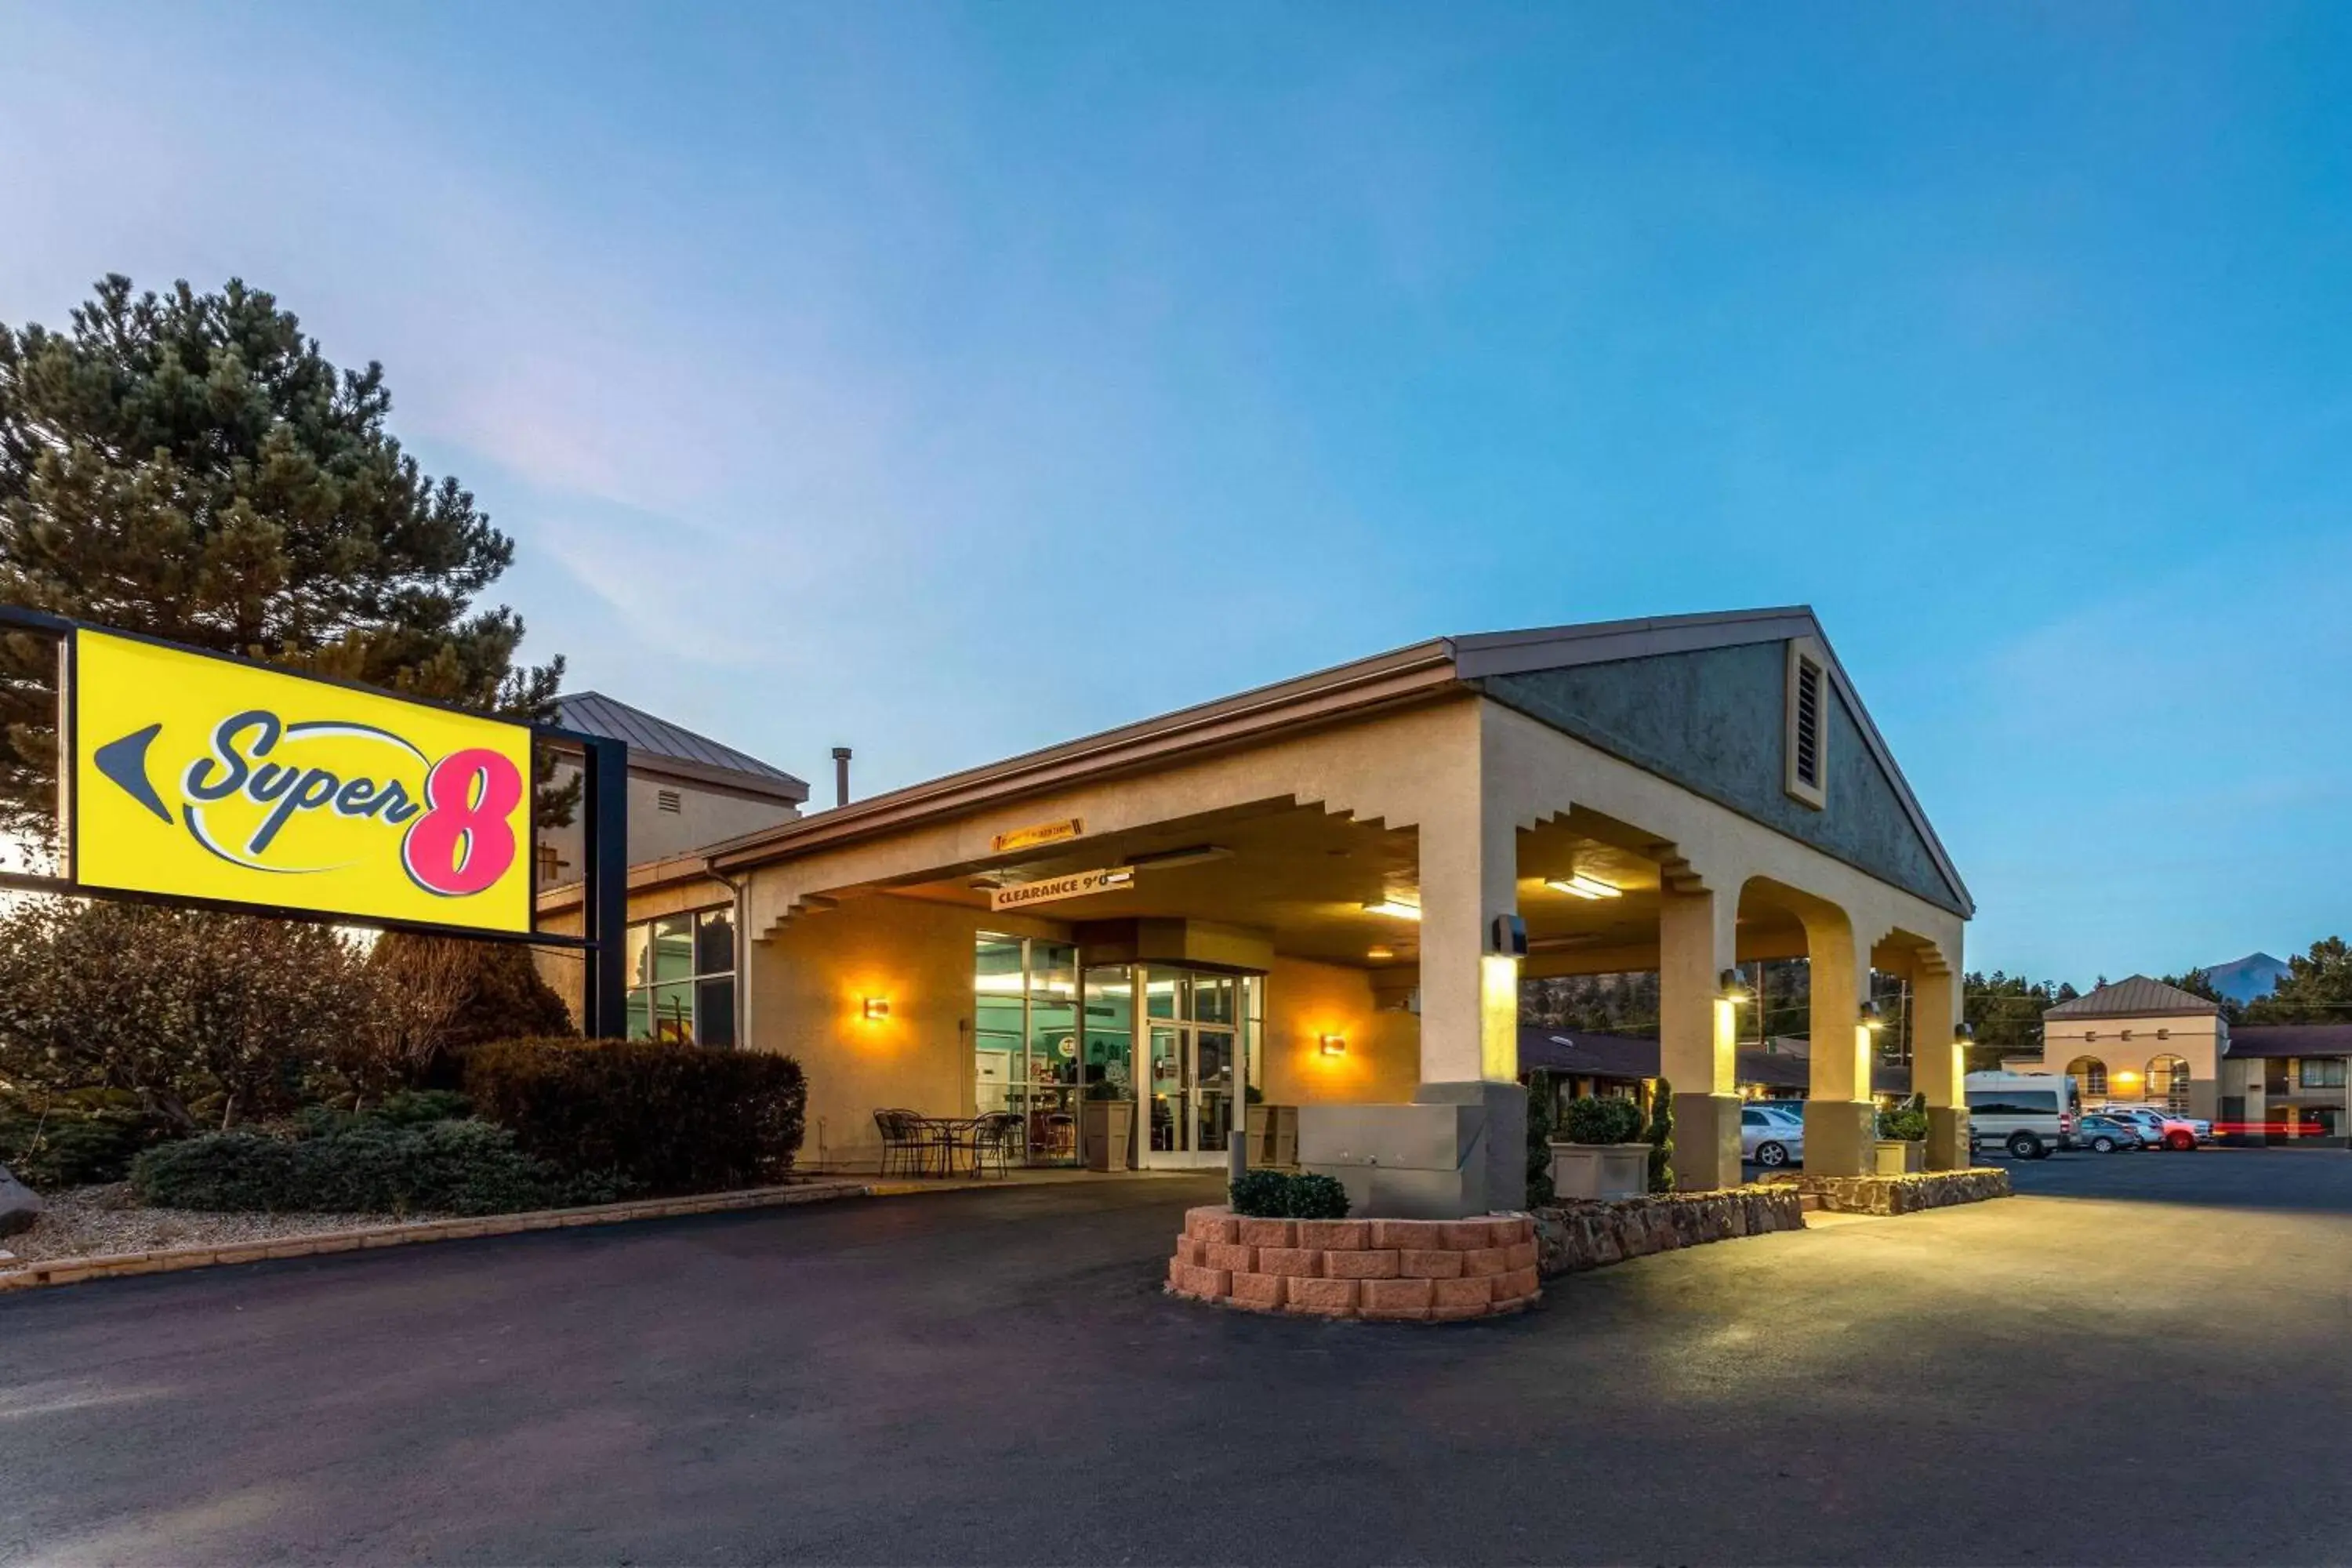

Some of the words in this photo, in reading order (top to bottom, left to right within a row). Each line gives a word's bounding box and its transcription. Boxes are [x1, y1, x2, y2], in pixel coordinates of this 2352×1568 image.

[183, 710, 420, 855] Super
[401, 748, 522, 897] 8
[998, 880, 1078, 904] CLEARANCE
